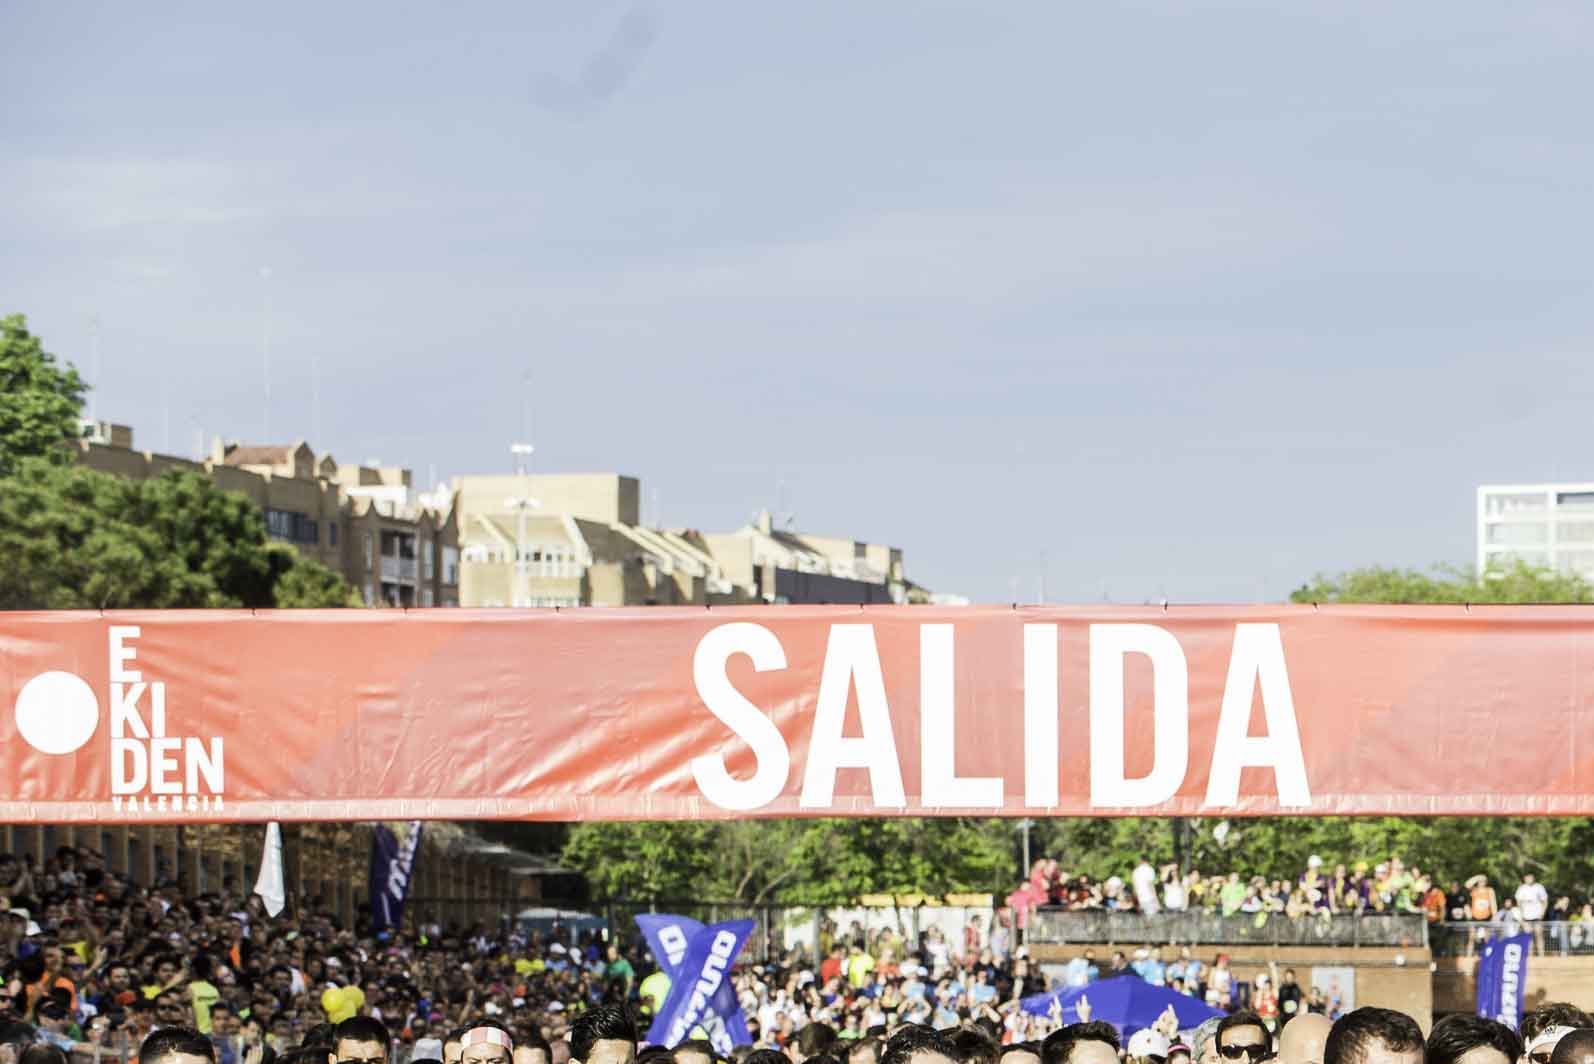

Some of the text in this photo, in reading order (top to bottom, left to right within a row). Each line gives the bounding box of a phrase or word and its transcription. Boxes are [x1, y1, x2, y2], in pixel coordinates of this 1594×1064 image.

[109, 682, 165, 738] KI
[690, 621, 1313, 811] SALIDA
[111, 738, 225, 794] DEN
[112, 796, 225, 812] VALENCIA
